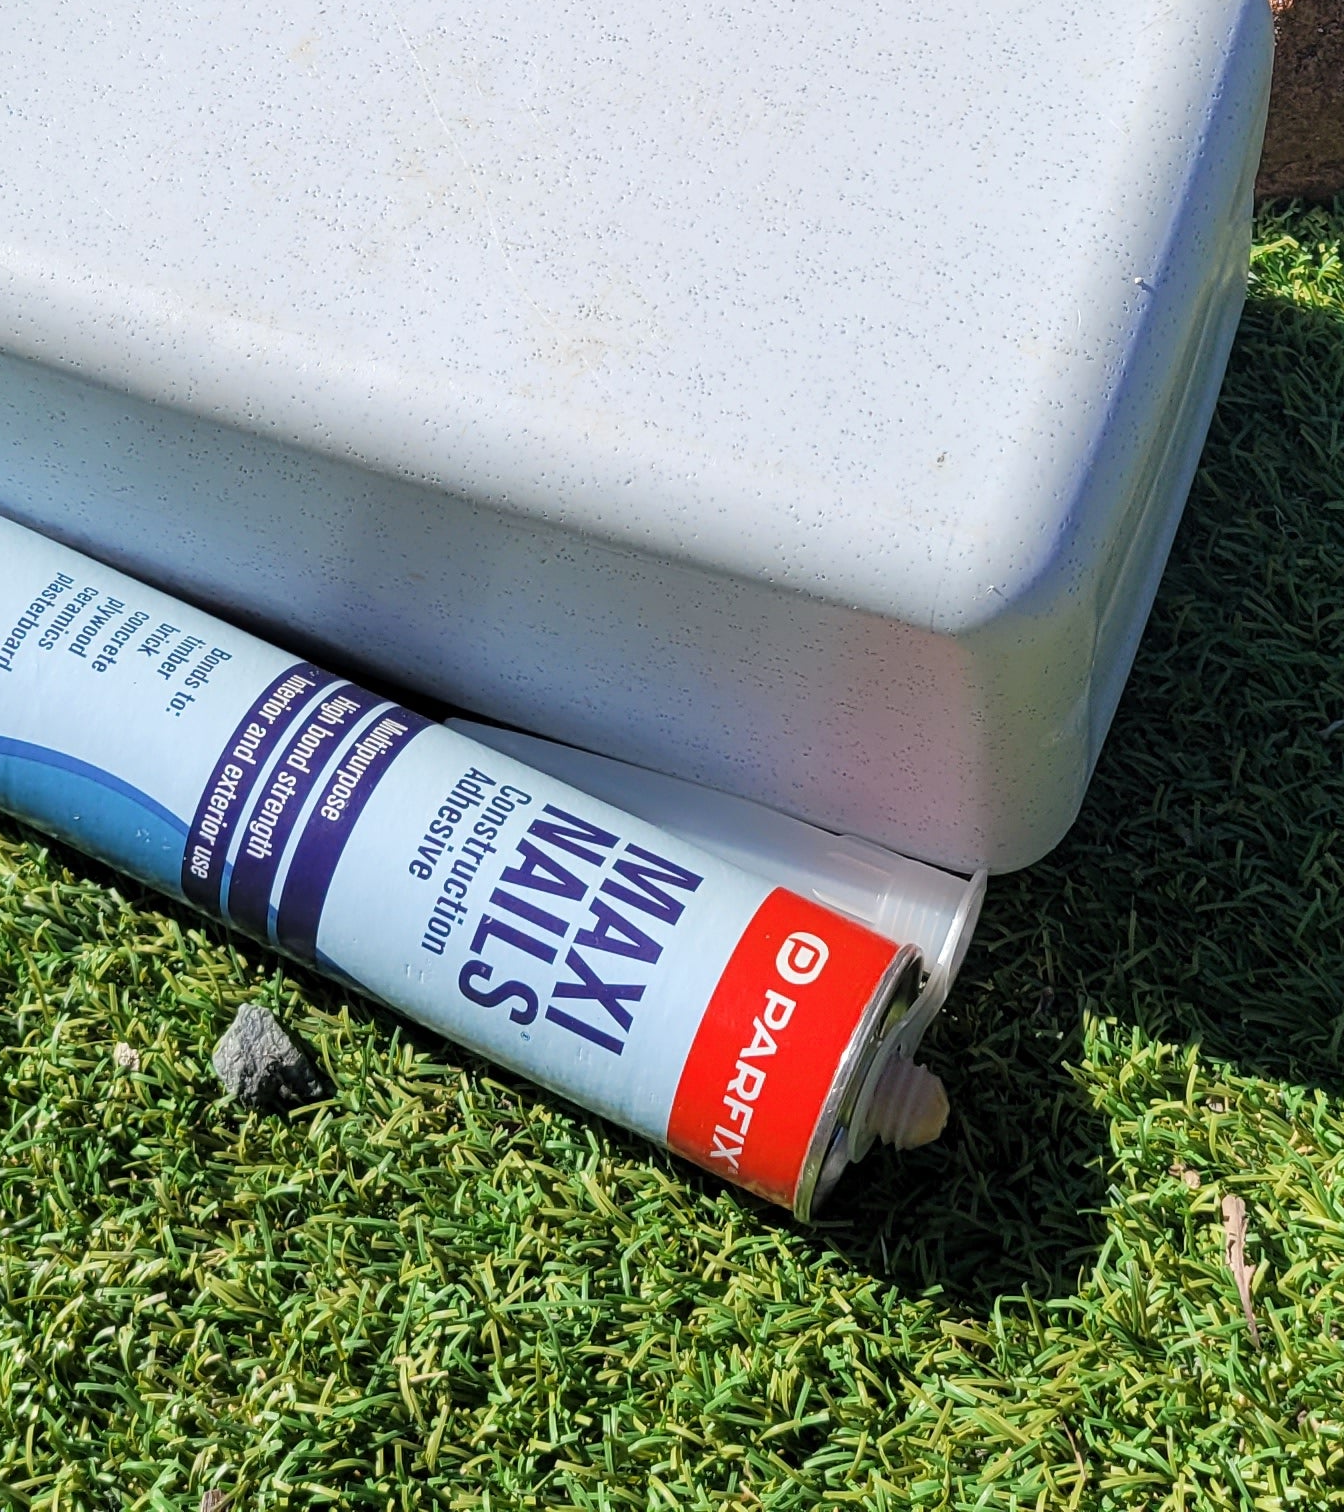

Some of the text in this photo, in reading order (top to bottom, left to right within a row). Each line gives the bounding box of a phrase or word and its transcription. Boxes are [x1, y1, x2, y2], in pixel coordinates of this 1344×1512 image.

[38, 586, 100, 651] ceramics
[68, 596, 126, 659] plywood
[91, 610, 151, 674] concrete
[136, 622, 181, 658] brick
[155, 635, 207, 681] timber
[165, 646, 233, 718] Bonds to:
[190, 673, 317, 880] Interior and exterior use
[245, 695, 361, 860] High bond strength
[320, 717, 409, 822] Multipurpose
[408, 766, 497, 881] Adhesive
[421, 784, 533, 956] Construction
[458, 803, 622, 1026] NAILS
[544, 842, 705, 1057] MAXI
[709, 988, 797, 1170] PARFIX
